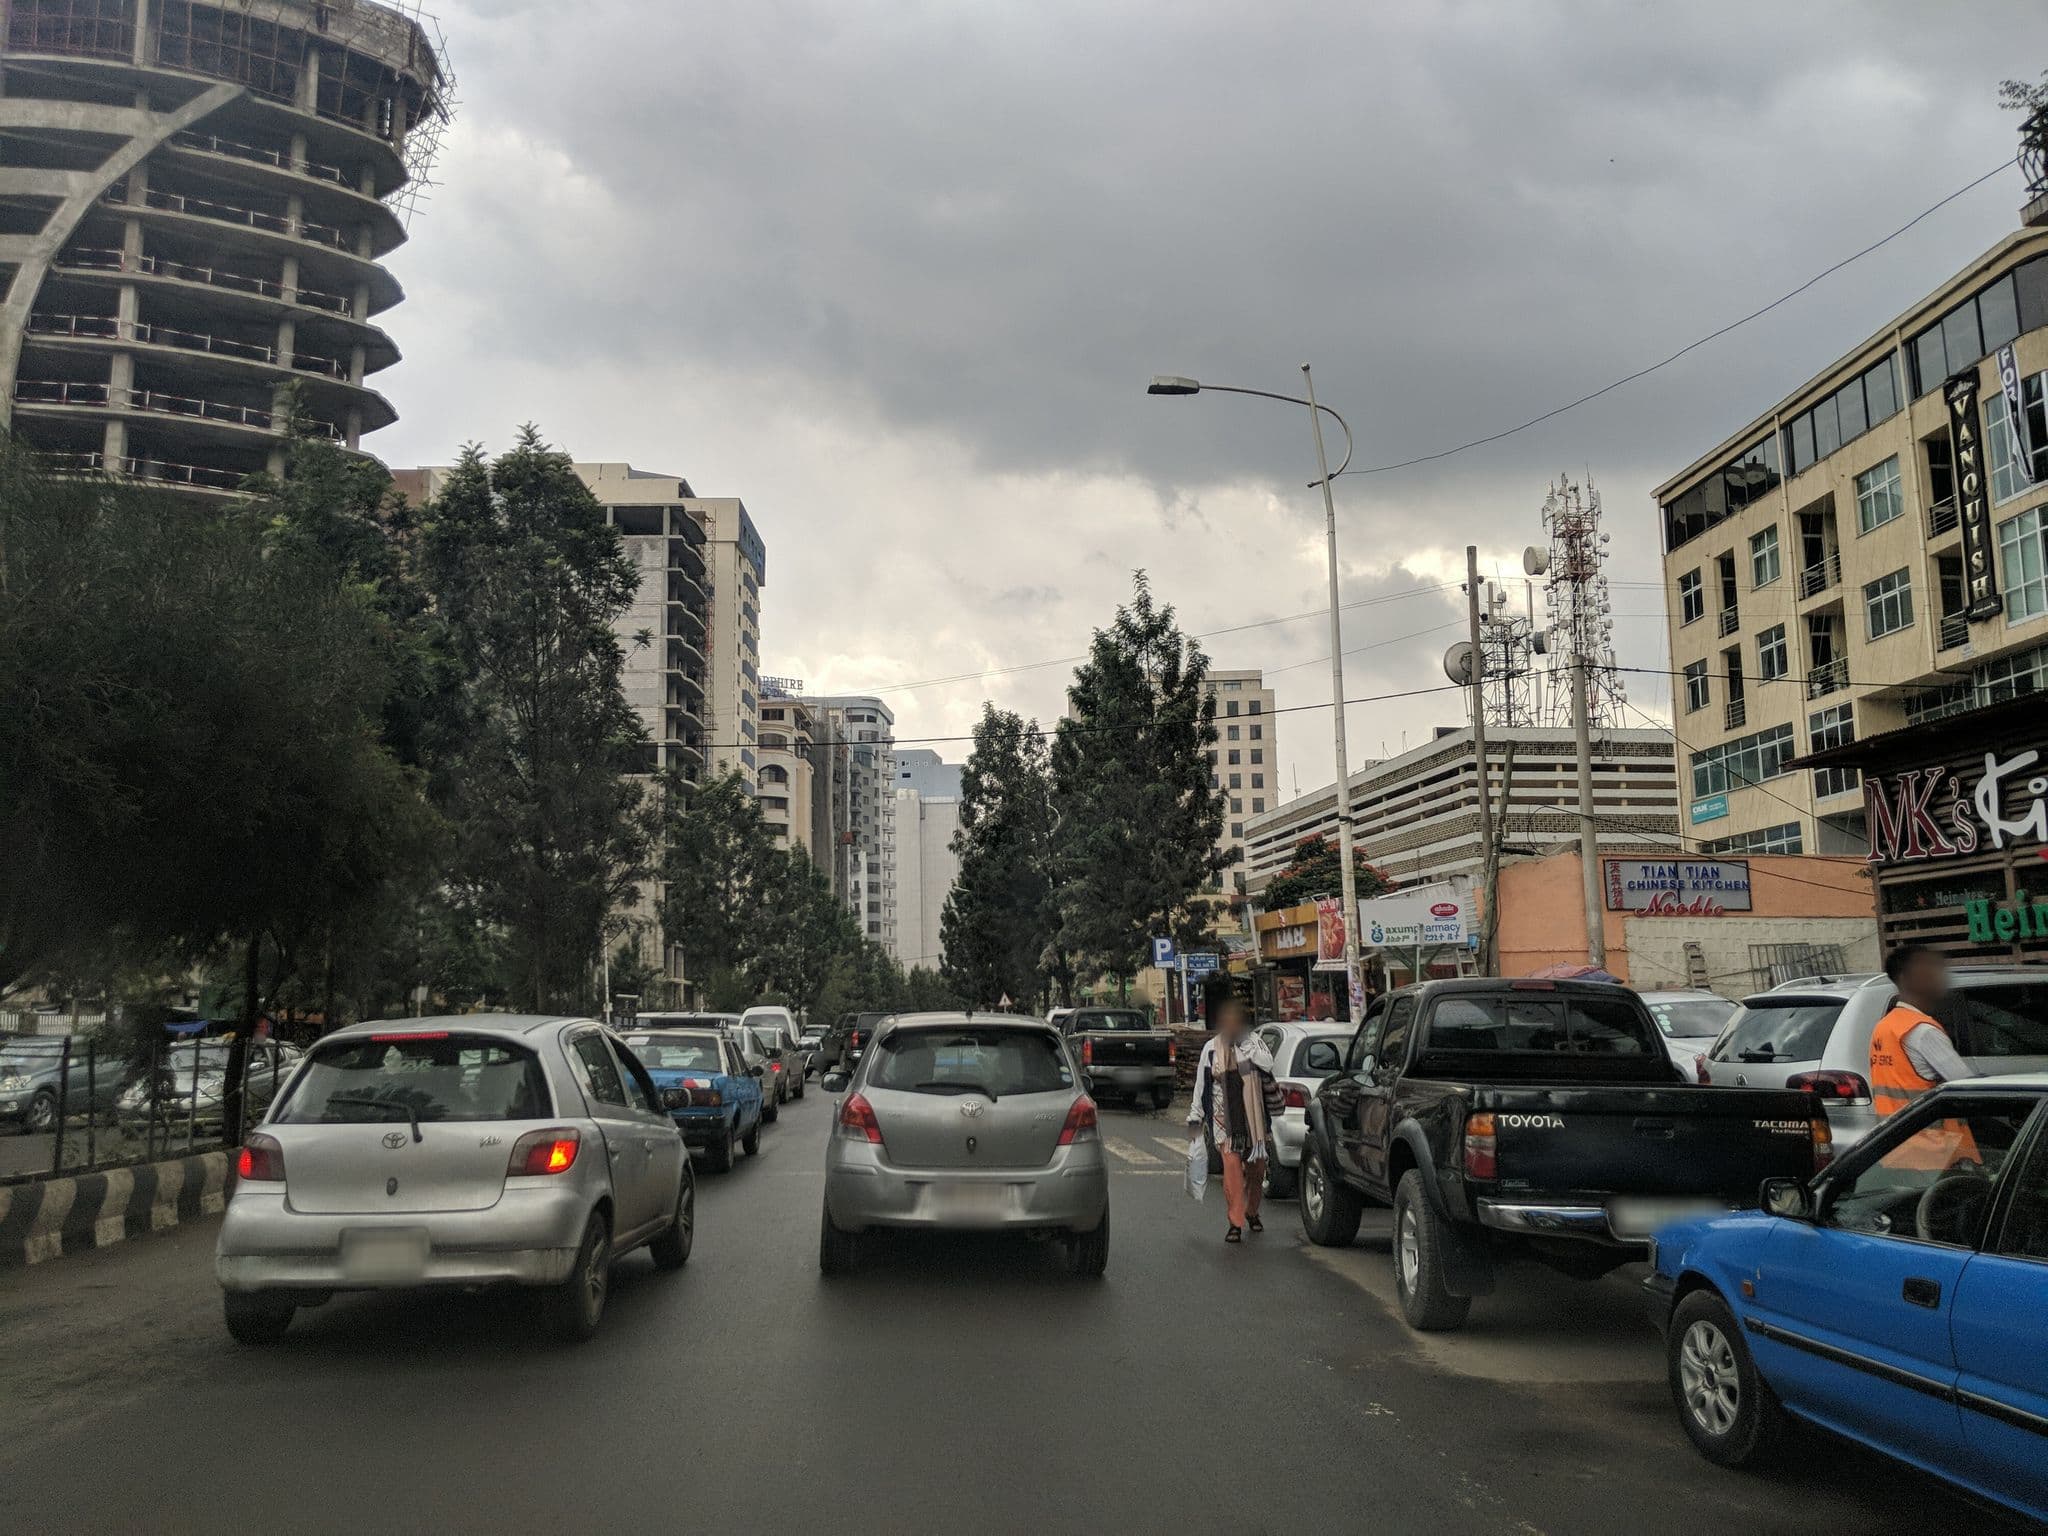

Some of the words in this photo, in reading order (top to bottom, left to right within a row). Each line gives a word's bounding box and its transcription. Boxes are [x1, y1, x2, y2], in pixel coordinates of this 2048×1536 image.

[1953, 395, 1989, 601] VANQUISH
[760, 676, 804, 690] PPHIRE
[1865, 766, 1978, 862] MK's
[1641, 865, 1678, 879] TIAN
[1685, 866, 1721, 880] TIAN
[1627, 879, 1686, 891] CHINESE
[1692, 880, 1751, 891] KITCHEN
[1634, 890, 1725, 918] Noodle
[1155, 938, 1171, 961] P
[1498, 1114, 1566, 1128] TOYOTA
[1752, 1120, 1809, 1129] TACOMA
